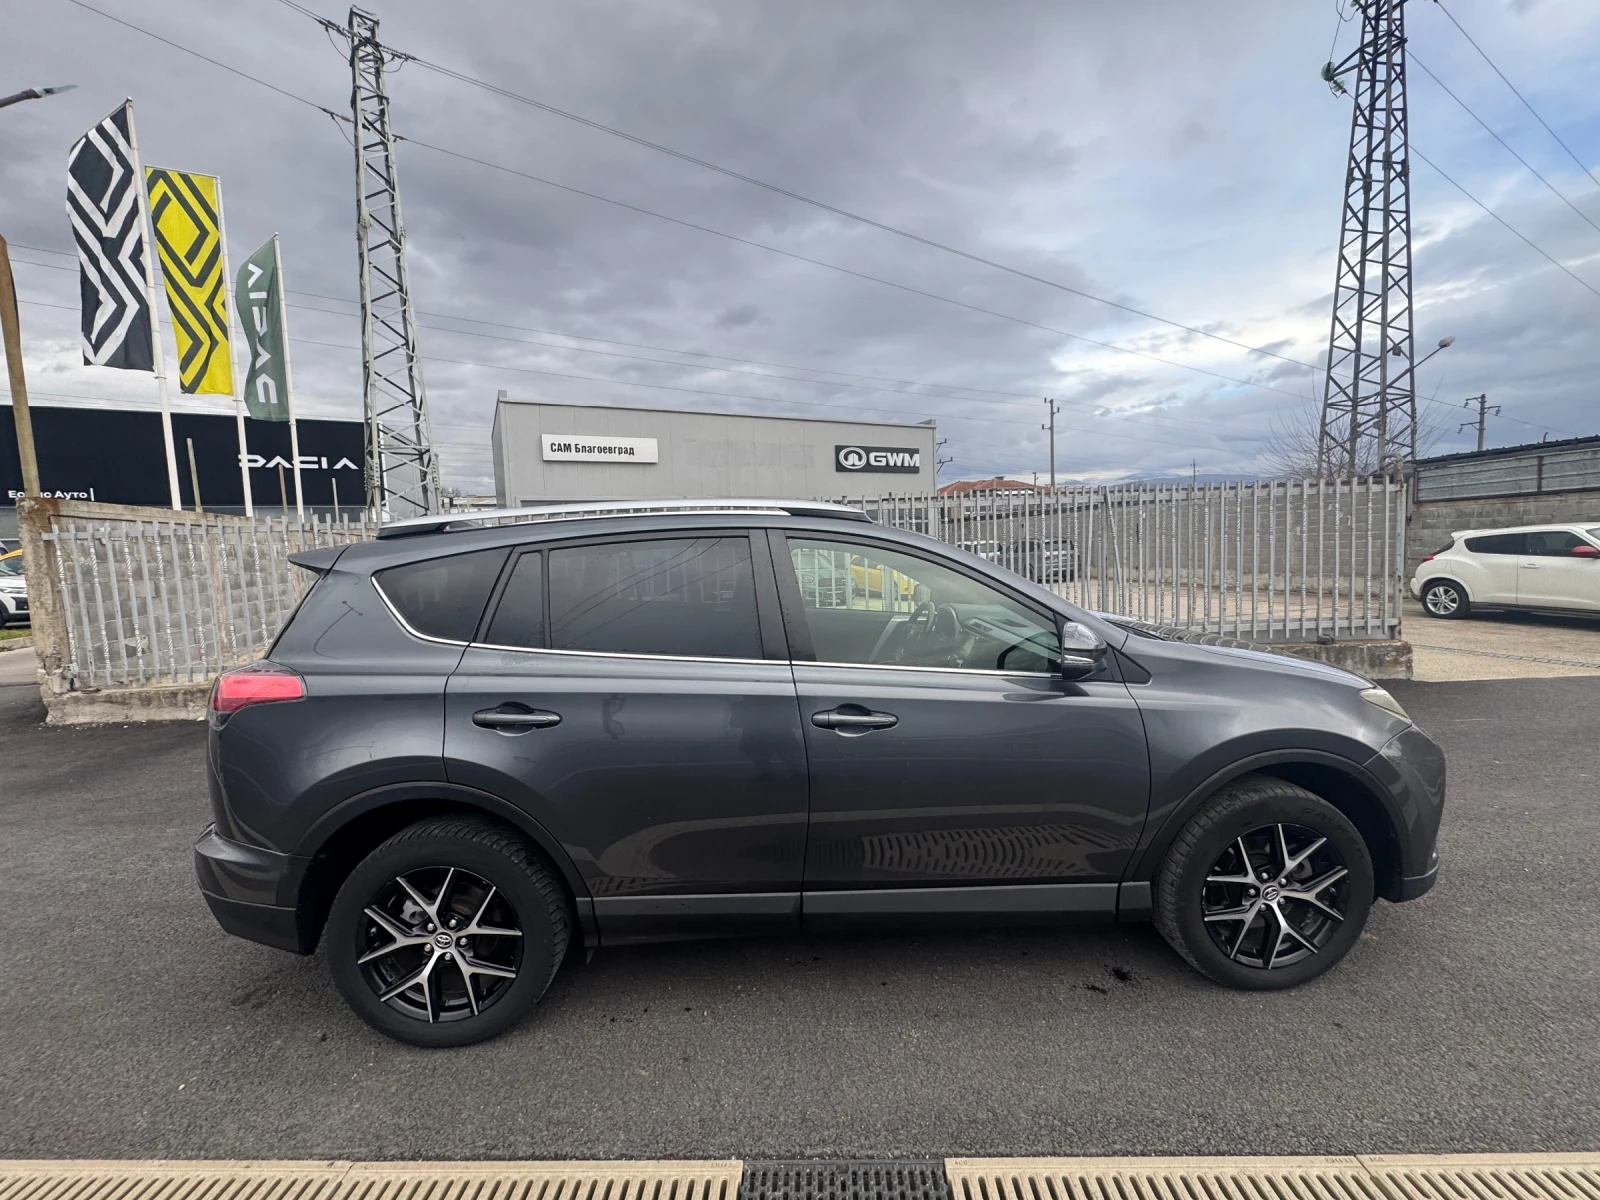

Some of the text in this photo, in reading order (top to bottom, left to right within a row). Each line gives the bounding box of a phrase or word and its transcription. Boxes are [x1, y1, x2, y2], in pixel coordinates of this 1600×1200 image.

[248, 263, 278, 404] DACIA
[550, 442, 635, 456] САМ Благоевград
[238, 454, 359, 469] DACIA
[869, 452, 920, 467] GWM
[54, 490, 88, 500] Ауто
